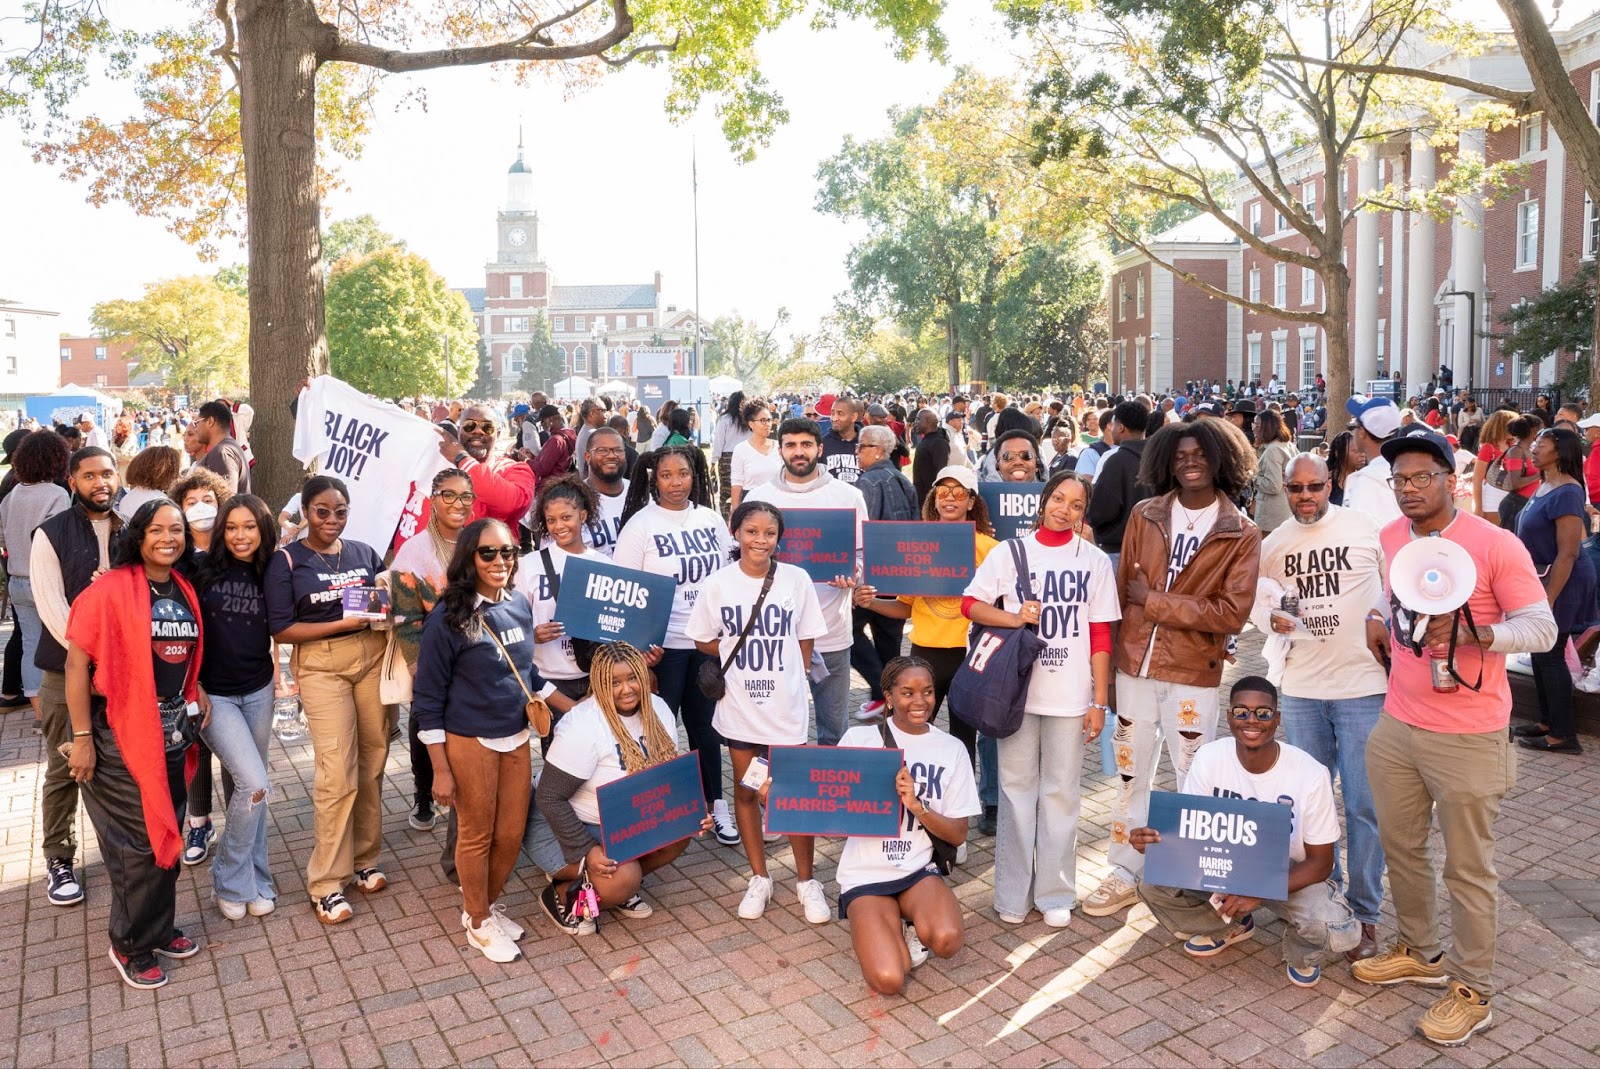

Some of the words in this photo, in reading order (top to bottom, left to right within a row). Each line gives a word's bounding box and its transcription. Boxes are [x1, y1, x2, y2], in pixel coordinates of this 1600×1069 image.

[325, 410, 389, 459] BLACK
[325, 443, 368, 482] JOY!
[841, 473, 855, 482] 1867
[653, 527, 722, 558] BLACK
[787, 540, 813, 550] FOR
[897, 541, 940, 553] BISON
[904, 554, 932, 565] FOR
[1285, 546, 1353, 577] BLACK
[317, 568, 368, 581] MADAM
[871, 565, 969, 578] HARRIS-WALZ
[585, 573, 649, 609] HBCUs
[1296, 572, 1341, 600] MEN
[222, 595, 260, 615] 2024
[598, 614, 626, 627] HARRIS
[1302, 614, 1340, 629] HARRIS
[151, 621, 199, 637] KAMALA
[601, 624, 620, 634] WALZ
[165, 645, 187, 655] 2024
[736, 638, 784, 672] JOY!
[1037, 648, 1069, 660] HARRIS
[1041, 659, 1065, 667] WALZ
[745, 679, 775, 690] HARRIS
[810, 769, 860, 783] BISON
[632, 783, 671, 808] BISON
[818, 785, 850, 798] FOR
[641, 800, 665, 818] FOR
[776, 798, 893, 814] HARRIS-WALZ
[610, 800, 698, 845] HARRIS-WALZ
[1179, 808, 1258, 847] HBCUs
[882, 841, 912, 853] HARRIS
[887, 853, 905, 861] WALZ
[1199, 856, 1233, 871] HARRIS
[1203, 868, 1228, 878] WALZ
